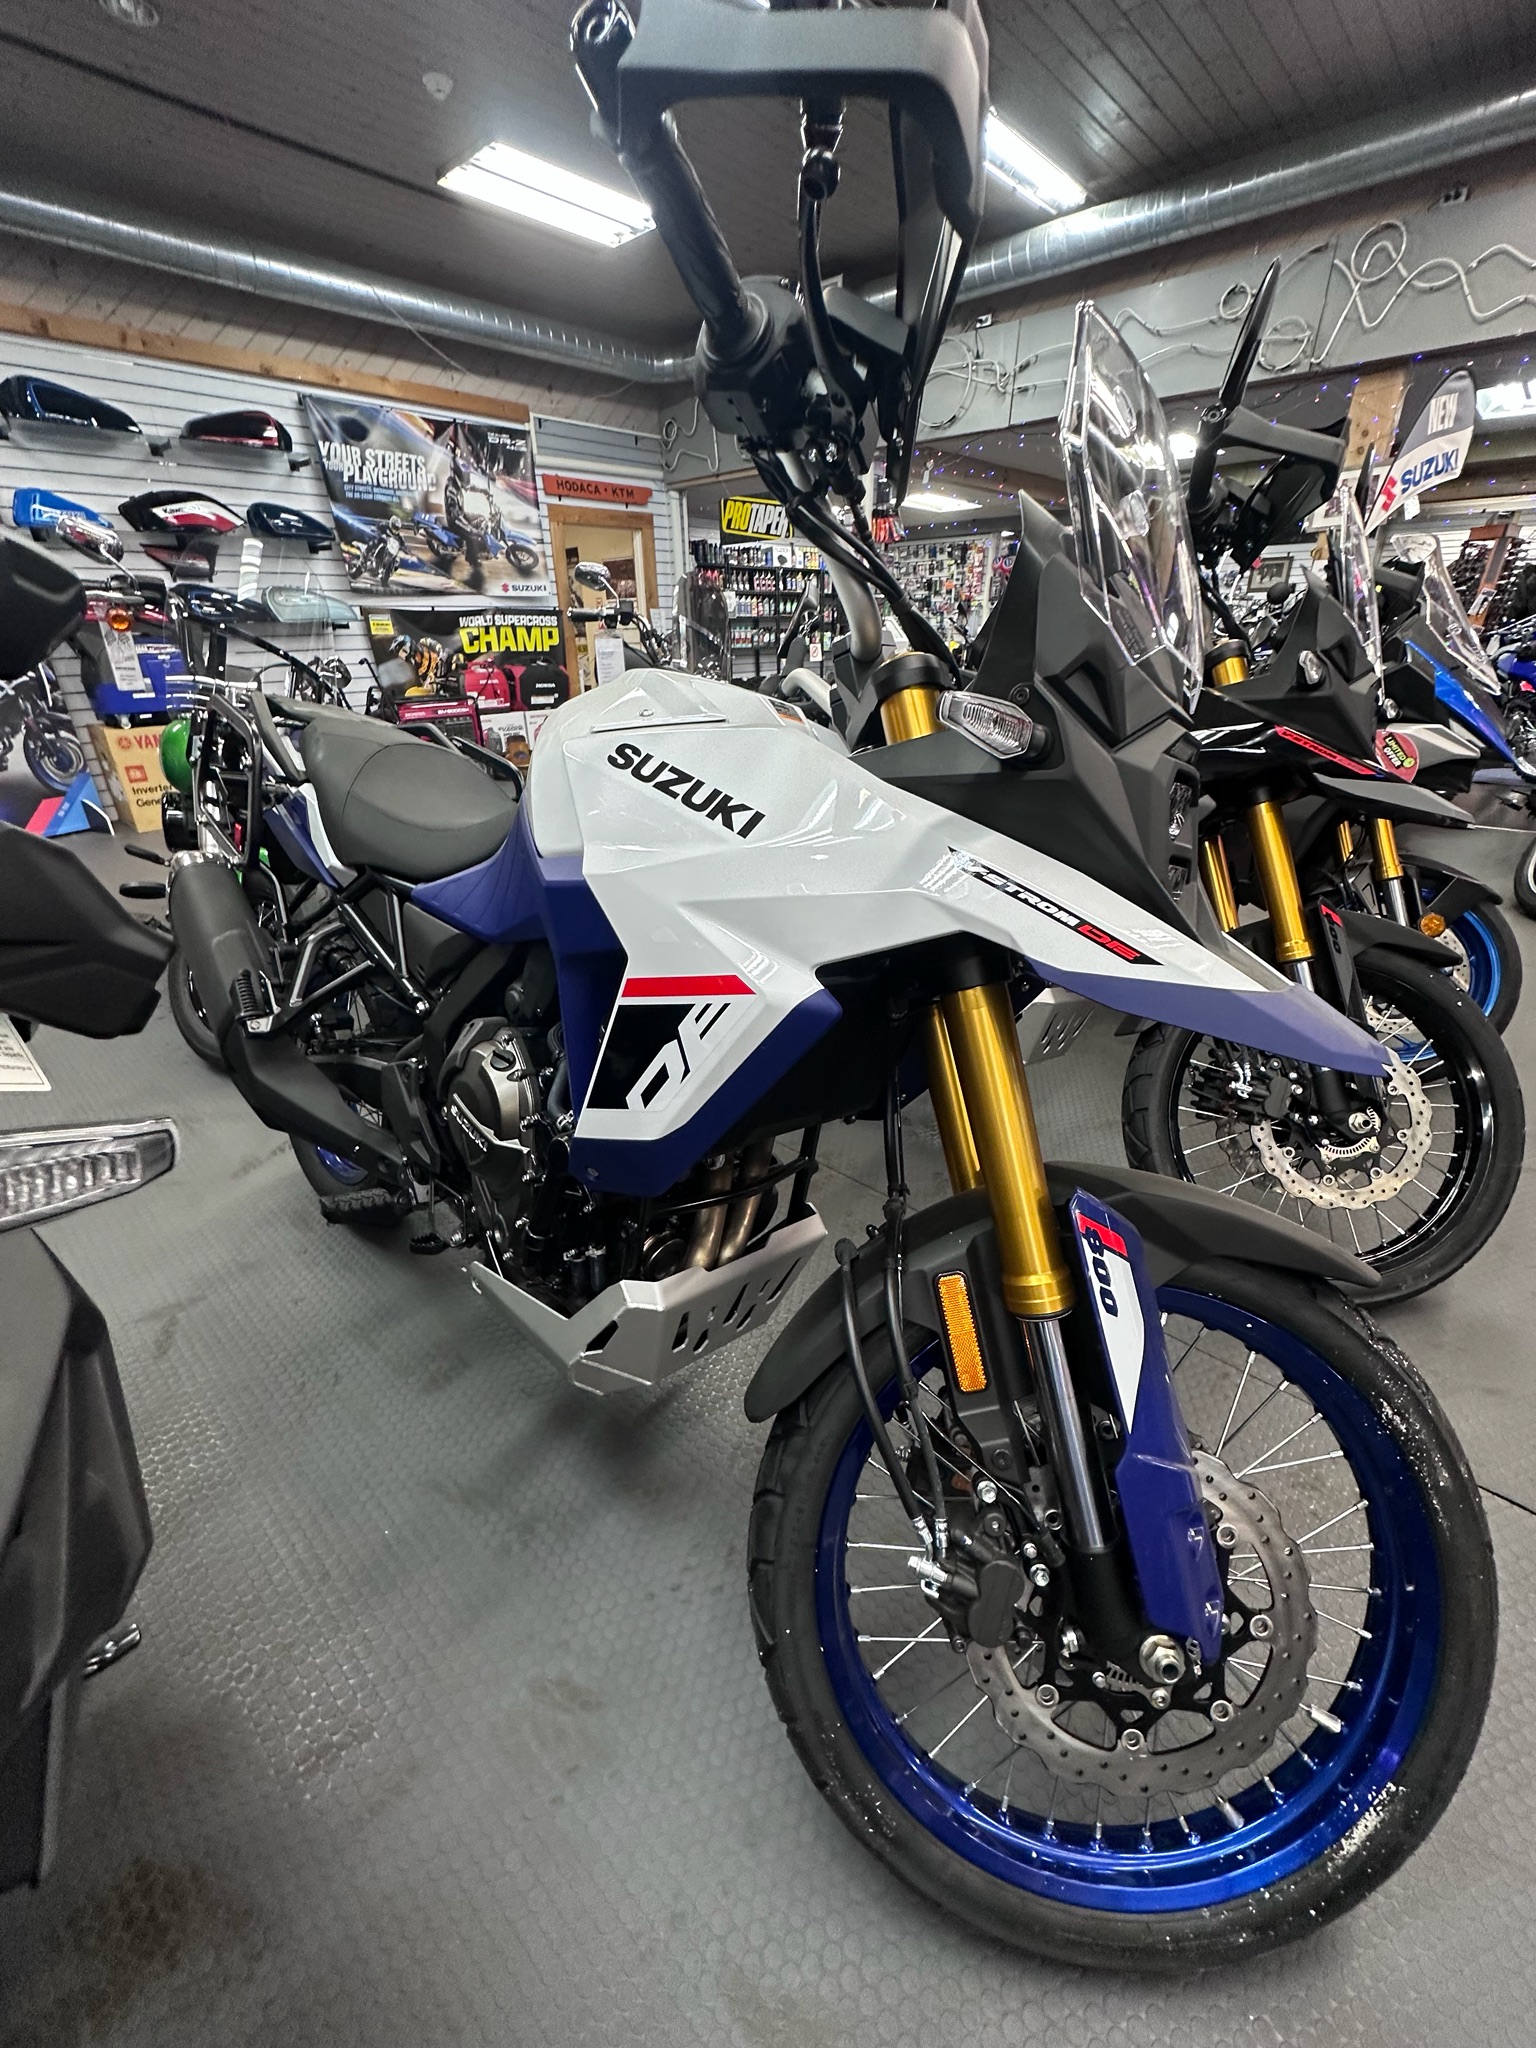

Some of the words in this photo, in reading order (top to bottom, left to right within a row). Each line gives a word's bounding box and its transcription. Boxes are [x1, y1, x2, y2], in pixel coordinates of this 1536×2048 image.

[1428, 392, 1459, 435] NEW
[318, 440, 362, 467] YOUR
[365, 448, 426, 475] STREETS
[1401, 448, 1460, 495] SUZUKI
[343, 460, 437, 492] PLAYGROUND
[556, 479, 601, 495] HODACA
[611, 487, 635, 499] KTM
[511, 584, 547, 592] SUZUKI
[459, 614, 493, 627] WORLD
[494, 615, 558, 627] SUPERCROSS
[459, 626, 560, 654] CHAMP
[1383, 746, 1402, 767] OFFER
[1385, 736, 1406, 761] LIMITED
[607, 743, 766, 839] SUZUKI
[967, 860, 1081, 927] V-STROM
[1077, 923, 1142, 961] DE
[450, 1104, 489, 1152] SUZUKI
[1082, 1224, 1119, 1318] 800
